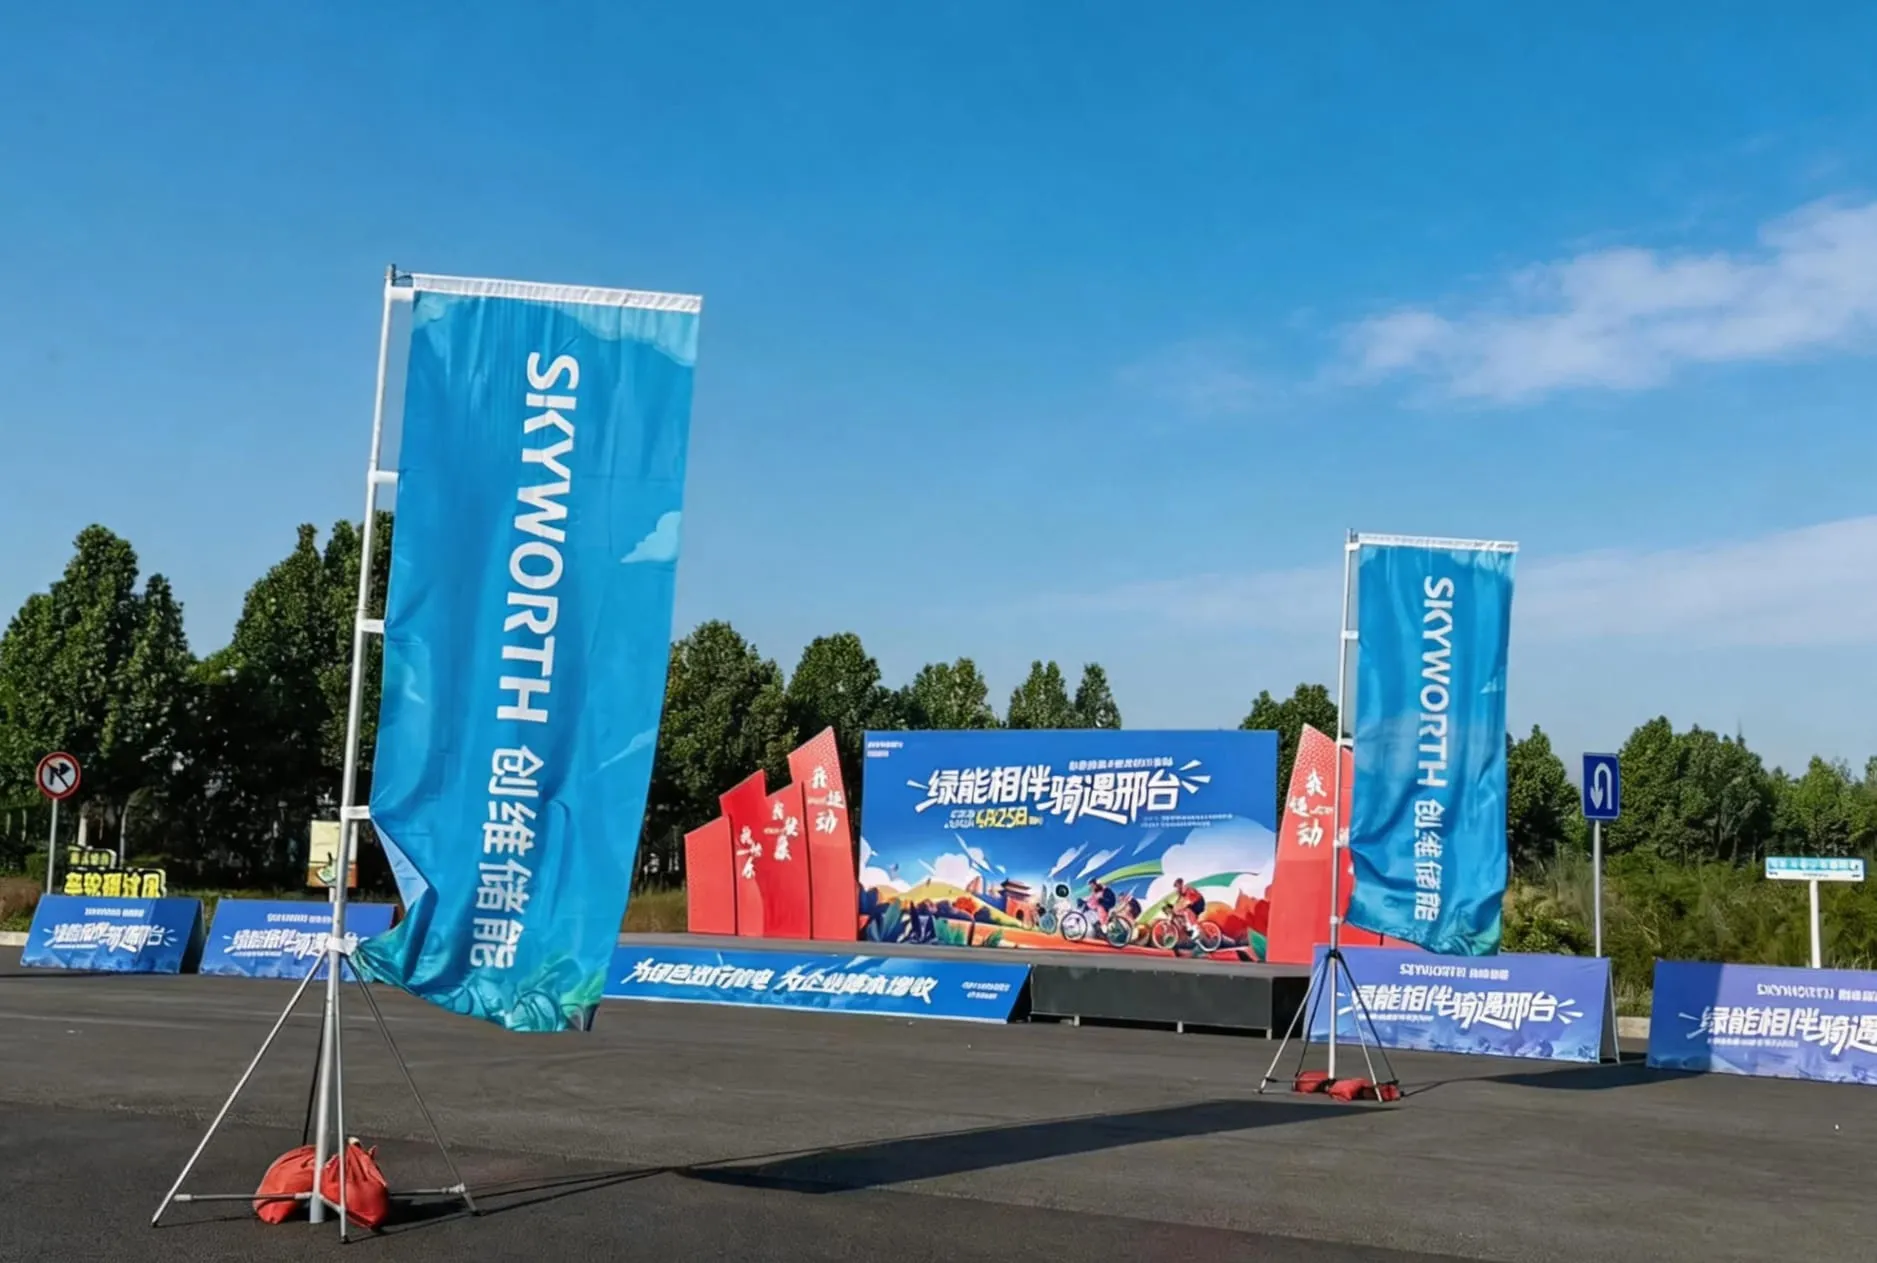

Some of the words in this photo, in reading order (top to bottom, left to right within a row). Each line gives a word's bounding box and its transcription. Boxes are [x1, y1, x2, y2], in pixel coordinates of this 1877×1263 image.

[494, 351, 581, 724] SKYWORTH
[1416, 575, 1455, 788] SKYWORTH
[469, 744, 545, 969] 创维储能
[1413, 798, 1446, 922] 创维储能
